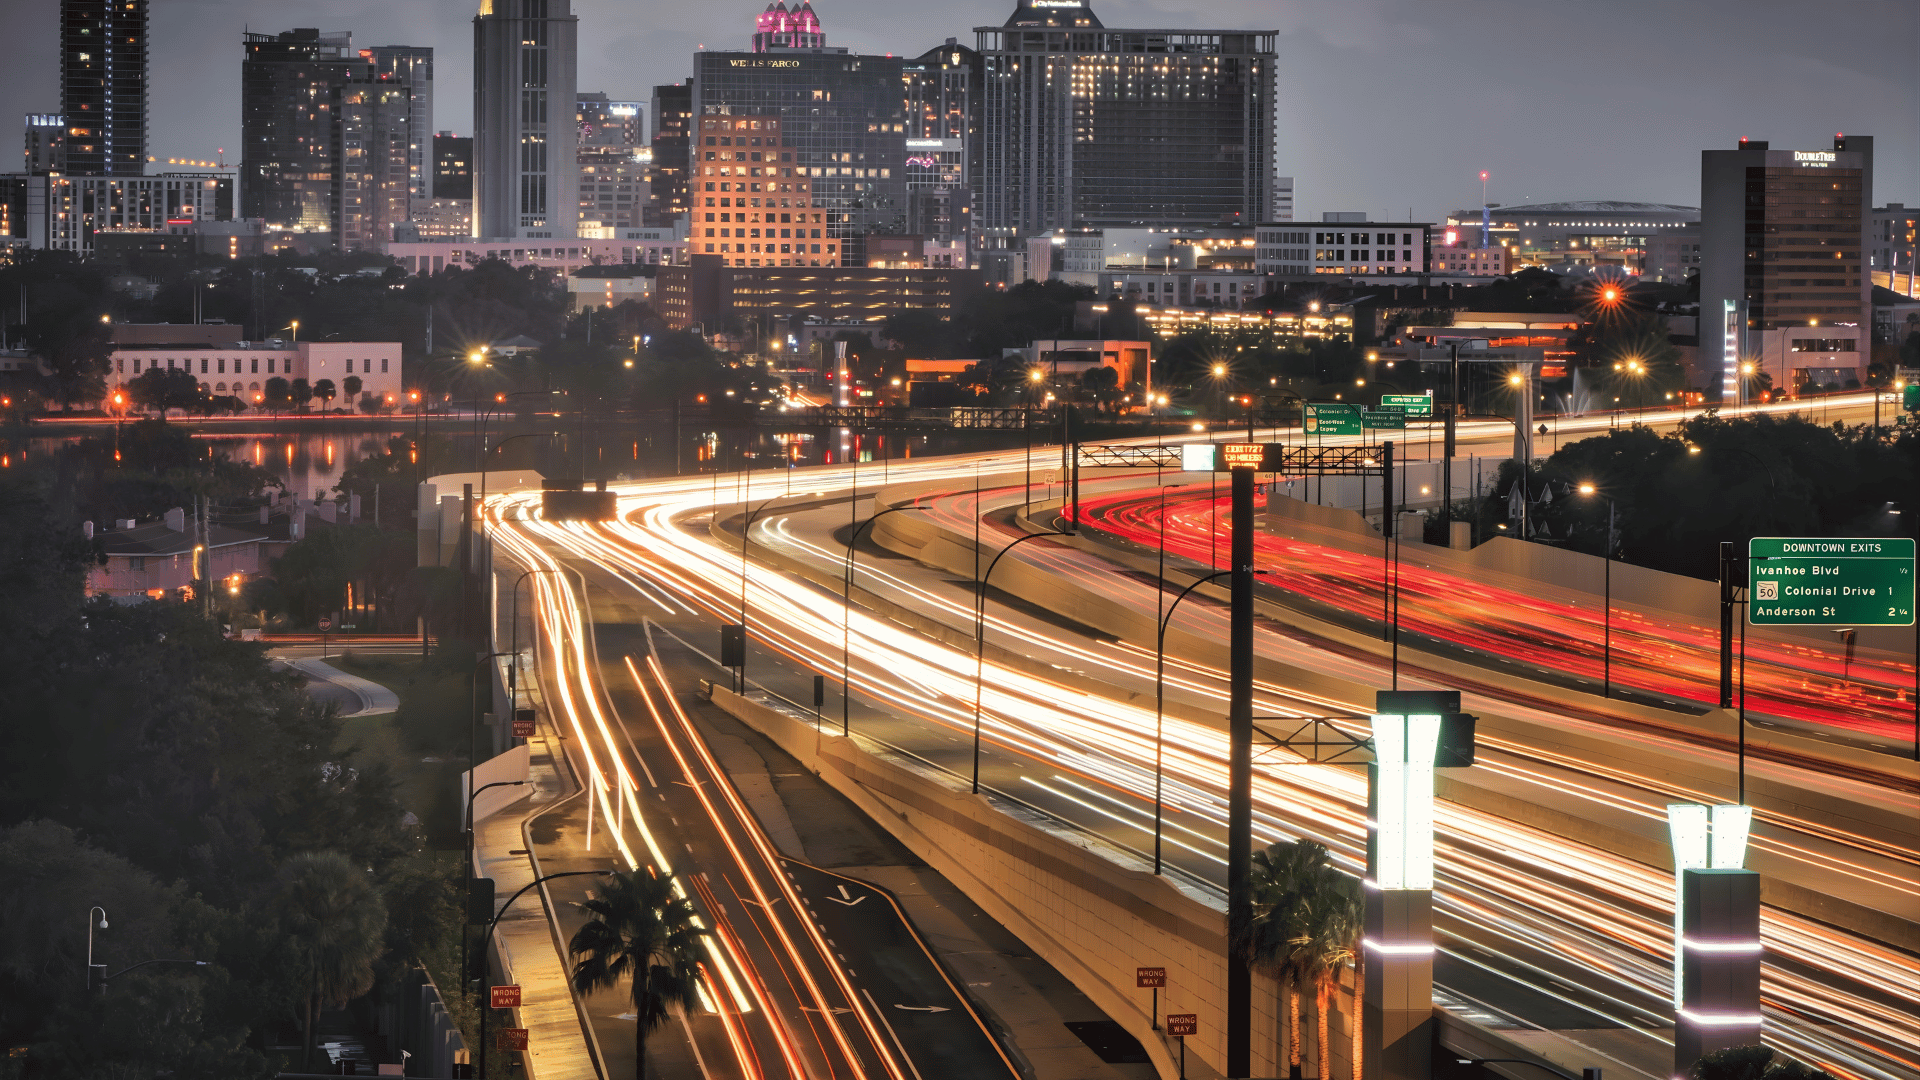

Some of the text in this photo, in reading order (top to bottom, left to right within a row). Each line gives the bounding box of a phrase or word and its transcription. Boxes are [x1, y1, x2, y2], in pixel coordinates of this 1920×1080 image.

[1783, 543, 1882, 553] DOWNTOWN EXITS
[1756, 565, 1806, 576] Ivanhoe
[1812, 565, 1839, 576] Blvd
[1760, 586, 1893, 598] 50 Colonial Drive 1
[1756, 606, 1816, 616] Anderson
[1822, 606, 1836, 616] St
[1888, 607, 1896, 617] 2
[493, 988, 520, 997] WRONG
[498, 997, 514, 1005] WAY
[1168, 1016, 1196, 1024] WRONG
[1173, 1025, 1190, 1033] WAY
